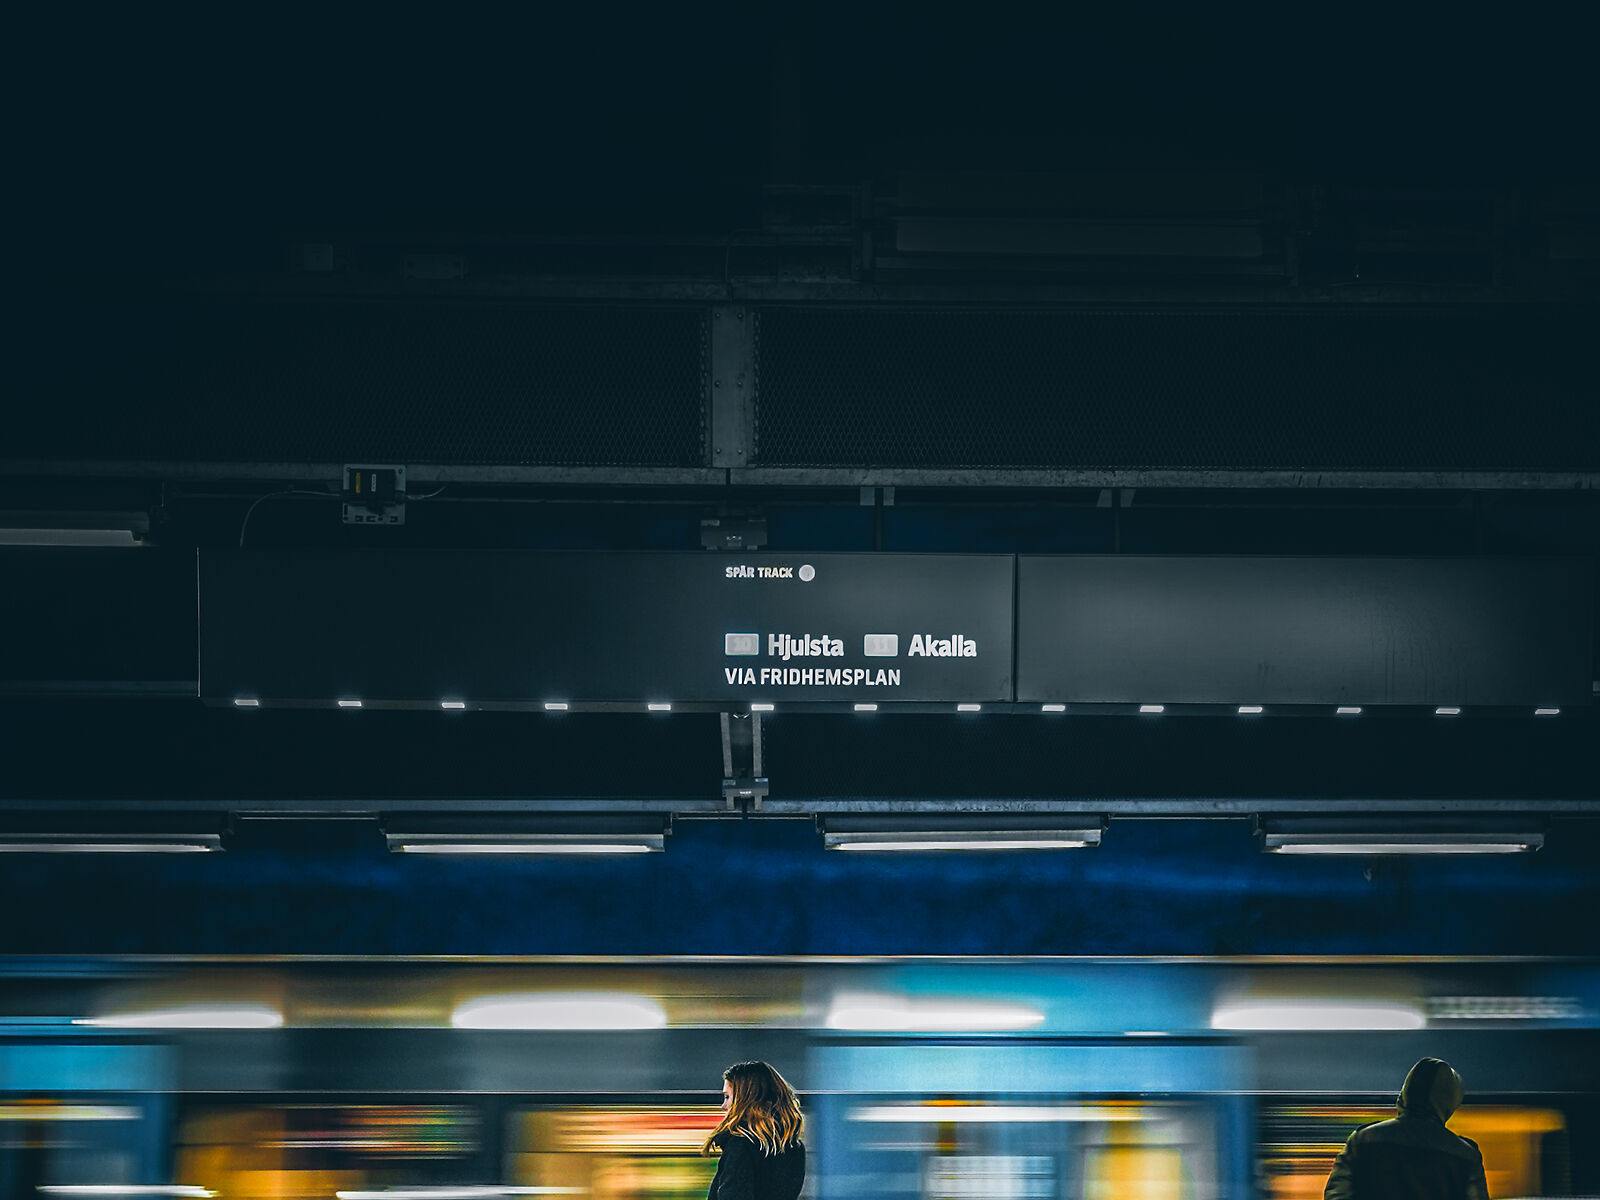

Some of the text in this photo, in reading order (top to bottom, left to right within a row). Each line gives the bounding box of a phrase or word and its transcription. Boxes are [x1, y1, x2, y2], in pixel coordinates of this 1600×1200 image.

[726, 566, 793, 578] SPÅR TRACK
[768, 634, 844, 660] Hjulsta
[908, 634, 977, 656] Akalla
[725, 668, 900, 685] VIA FRIDHEMSPLAN
